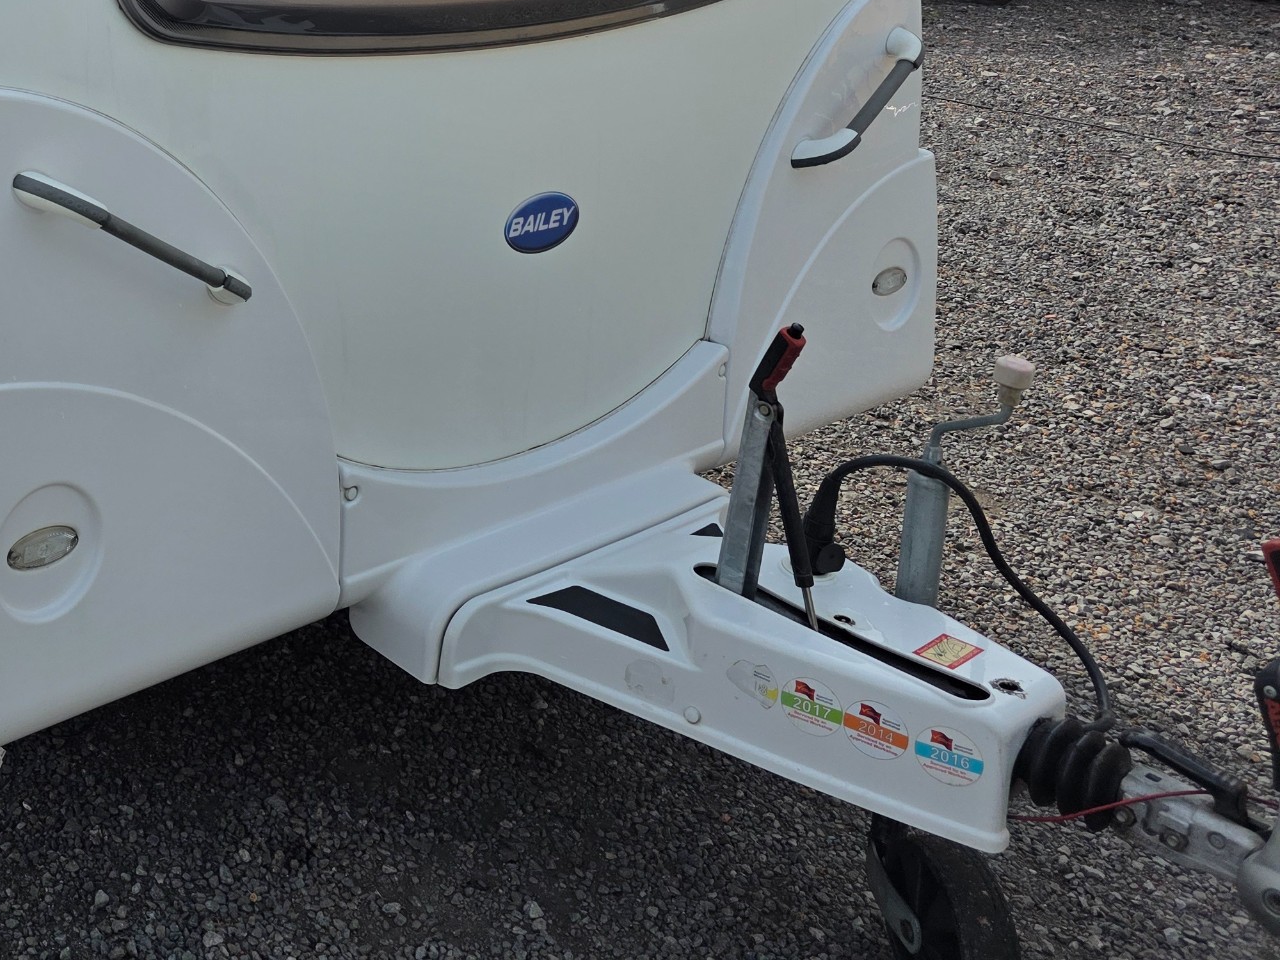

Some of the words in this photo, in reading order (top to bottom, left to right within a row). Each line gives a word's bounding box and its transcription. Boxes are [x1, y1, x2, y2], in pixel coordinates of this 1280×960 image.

[508, 206, 575, 238] BAILEY
[792, 697, 832, 719] 2017
[858, 720, 893, 743] 2014
[930, 747, 970, 769] 2016
